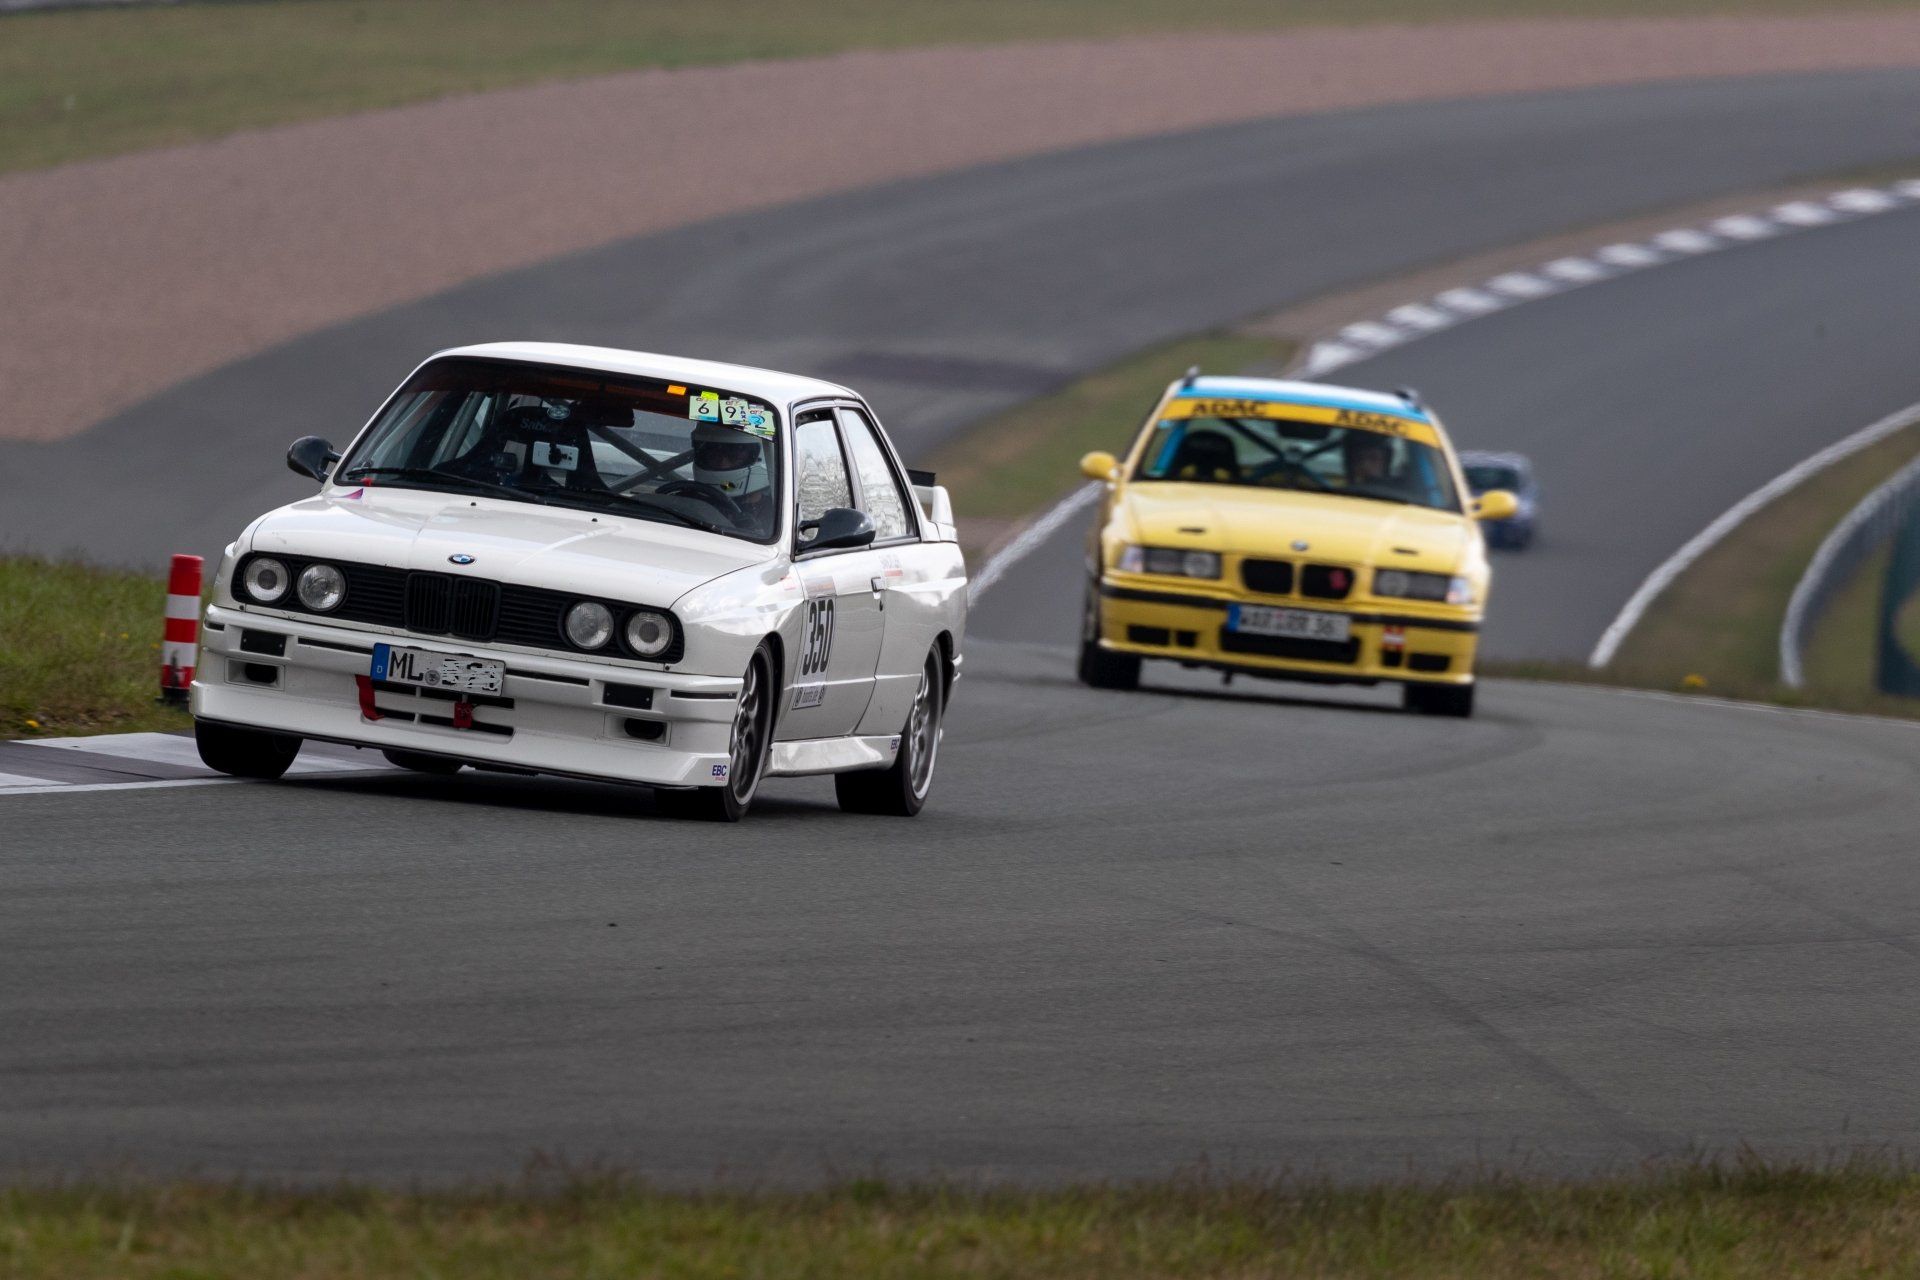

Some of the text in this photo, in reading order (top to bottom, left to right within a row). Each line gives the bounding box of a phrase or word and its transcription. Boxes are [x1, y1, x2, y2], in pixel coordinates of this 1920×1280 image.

[698, 403, 709, 414] 6
[725, 406, 737, 419] 9
[1191, 400, 1269, 417] ADAC
[1335, 409, 1409, 435] ADAC
[802, 599, 834, 676] 350
[389, 651, 424, 681] ML
[712, 765, 727, 776] EBC
